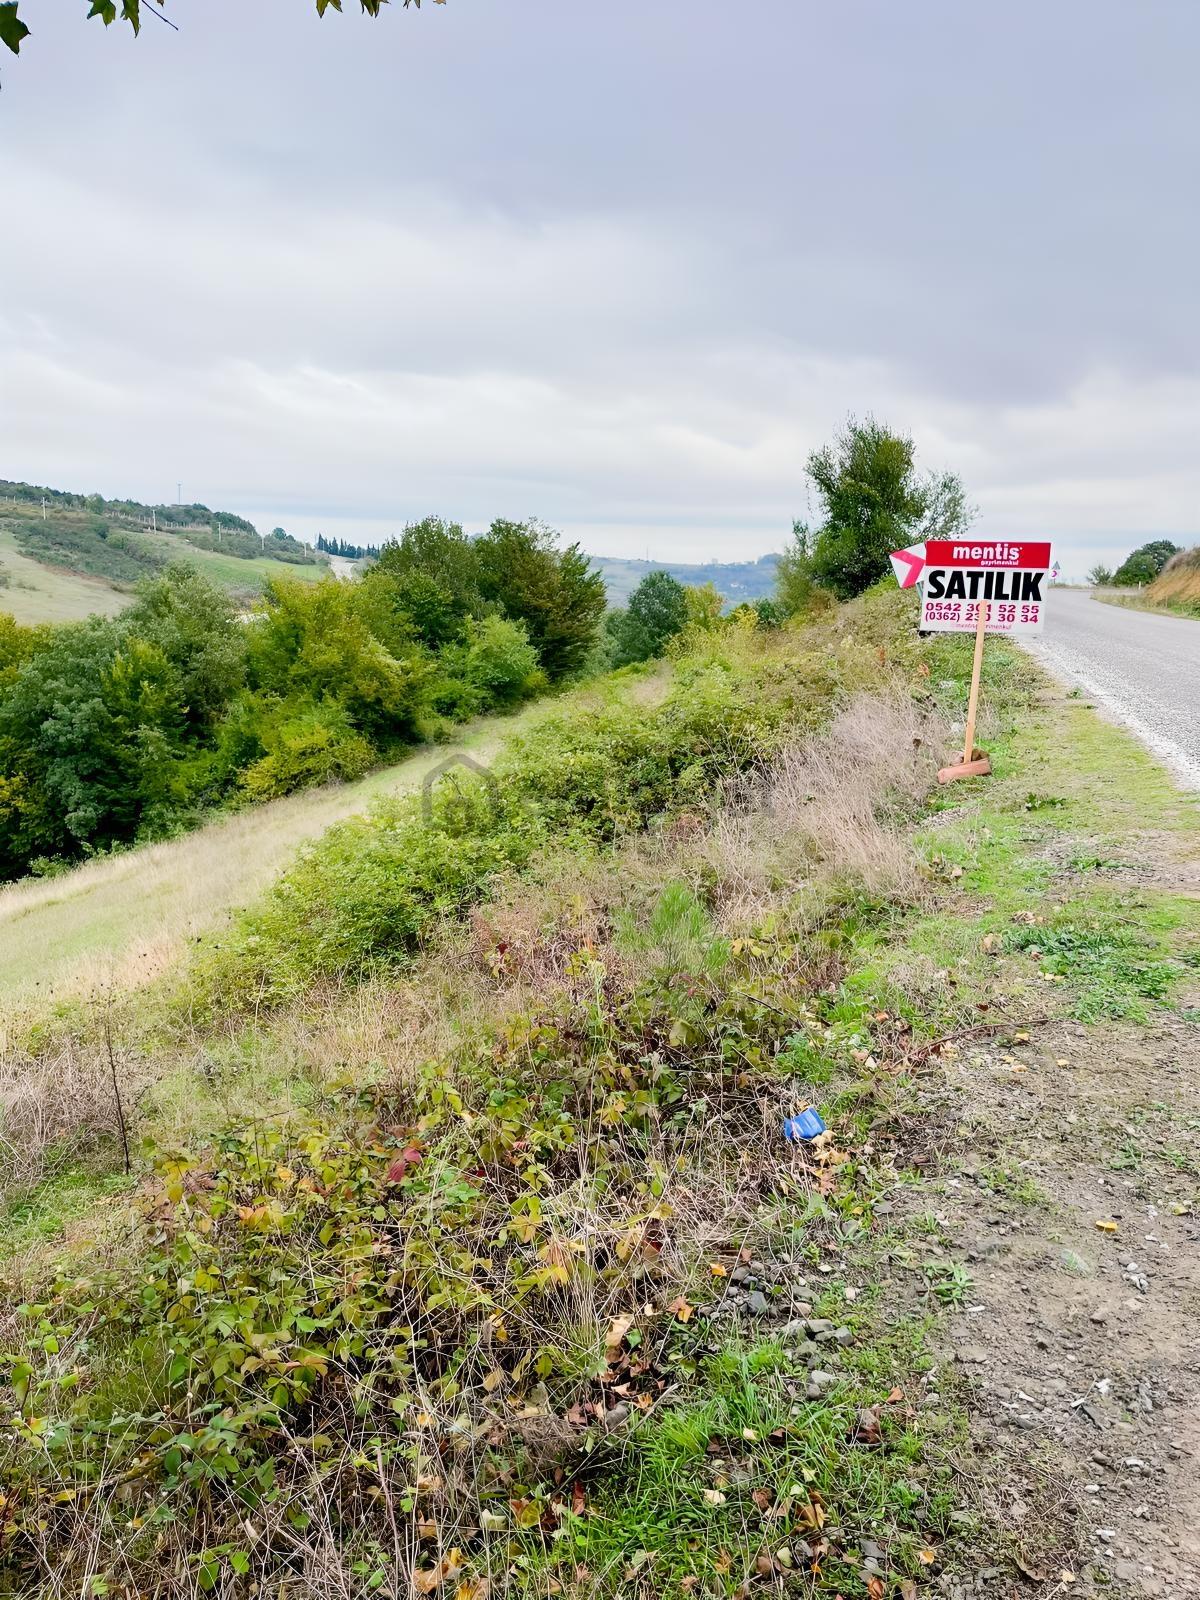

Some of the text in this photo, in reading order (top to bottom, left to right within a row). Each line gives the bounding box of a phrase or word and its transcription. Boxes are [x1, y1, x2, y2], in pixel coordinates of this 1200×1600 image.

[952, 543, 1020, 560] mentis
[927, 569, 1044, 602] SATILIK
[926, 602, 961, 612] 0542
[998, 604, 1016, 613] 52
[1021, 605, 1039, 614] 55
[925, 611, 960, 623] (0362)
[998, 613, 1015, 622] 30
[1020, 614, 1038, 624] 34
